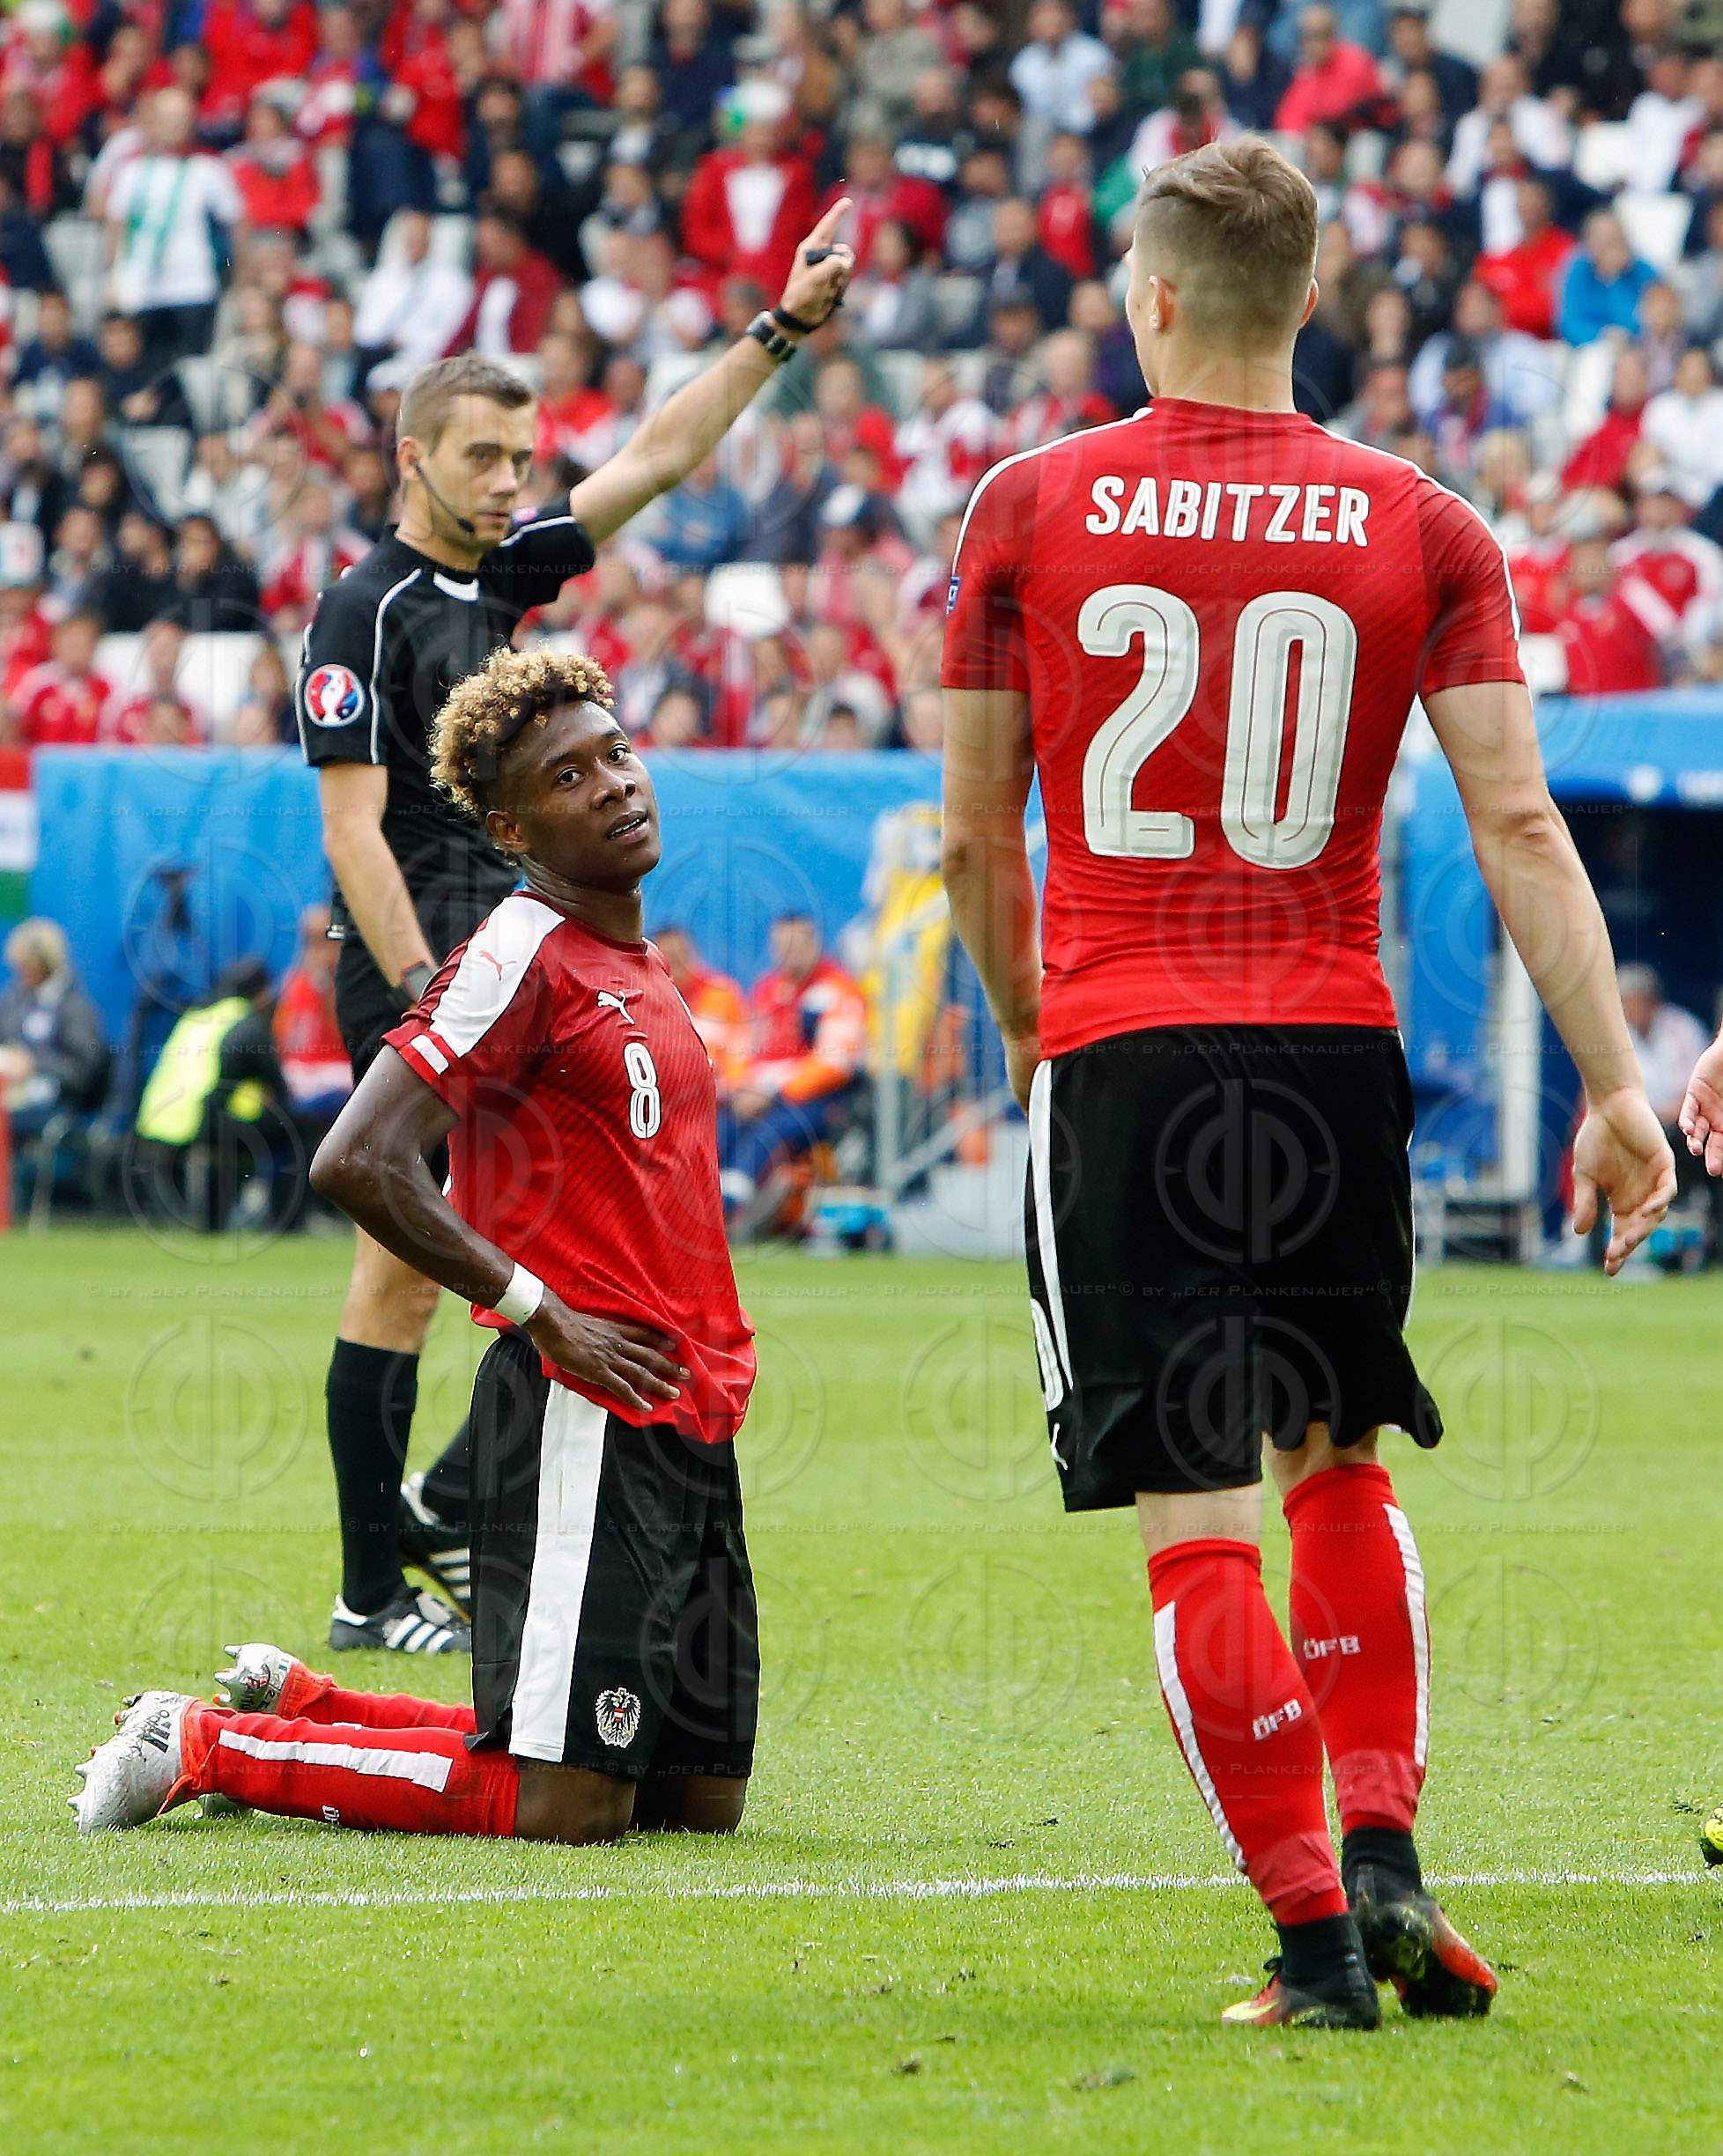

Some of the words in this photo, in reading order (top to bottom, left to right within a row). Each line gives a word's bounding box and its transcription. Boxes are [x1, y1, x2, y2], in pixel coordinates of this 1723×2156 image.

[1085, 475, 1371, 548] SABITZER
[1076, 583, 1359, 871] 20
[623, 1041, 662, 1140] 8
[1304, 1635, 1362, 1661] ÖFB
[1253, 1697, 1304, 1742] ÖFB
